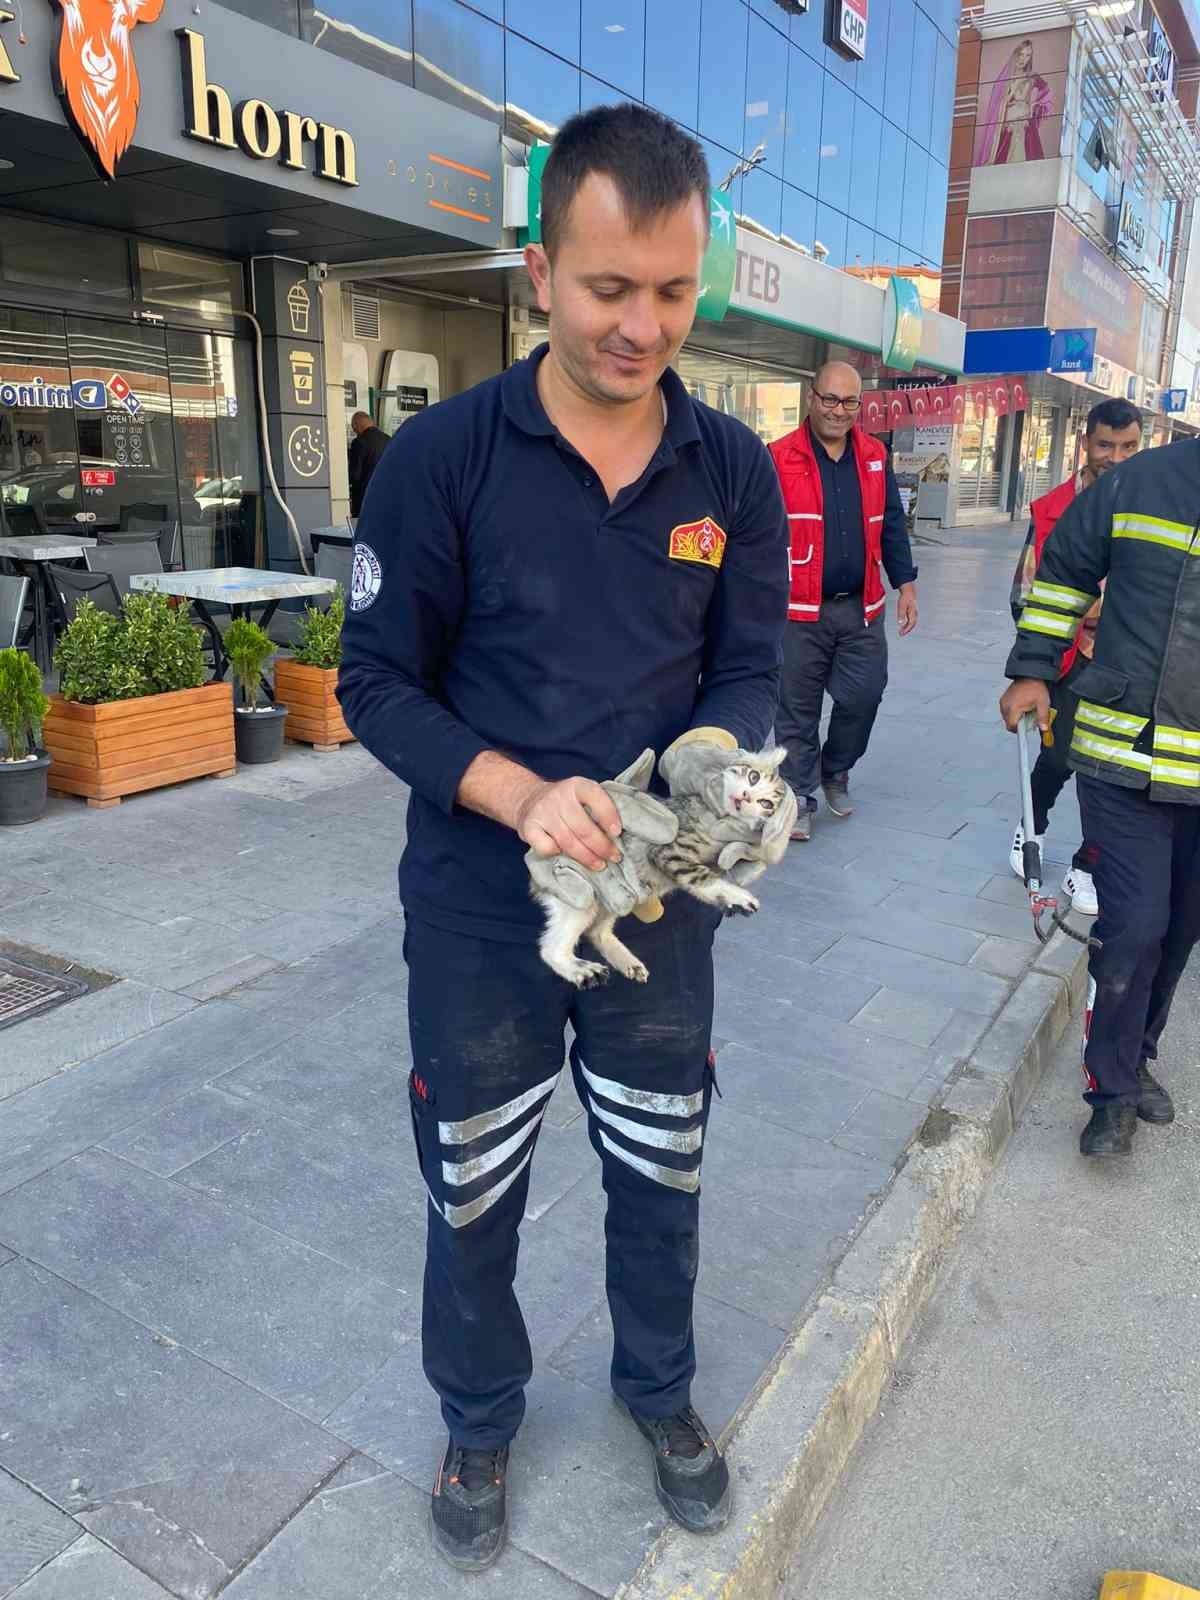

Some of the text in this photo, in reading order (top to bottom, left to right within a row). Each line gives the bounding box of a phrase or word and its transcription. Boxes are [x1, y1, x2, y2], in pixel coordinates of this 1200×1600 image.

[843, 8, 865, 45] CHP
[177, 27, 360, 187] horn
[735, 249, 781, 304] TEB
[106, 415, 145, 425] OPEN TIME
